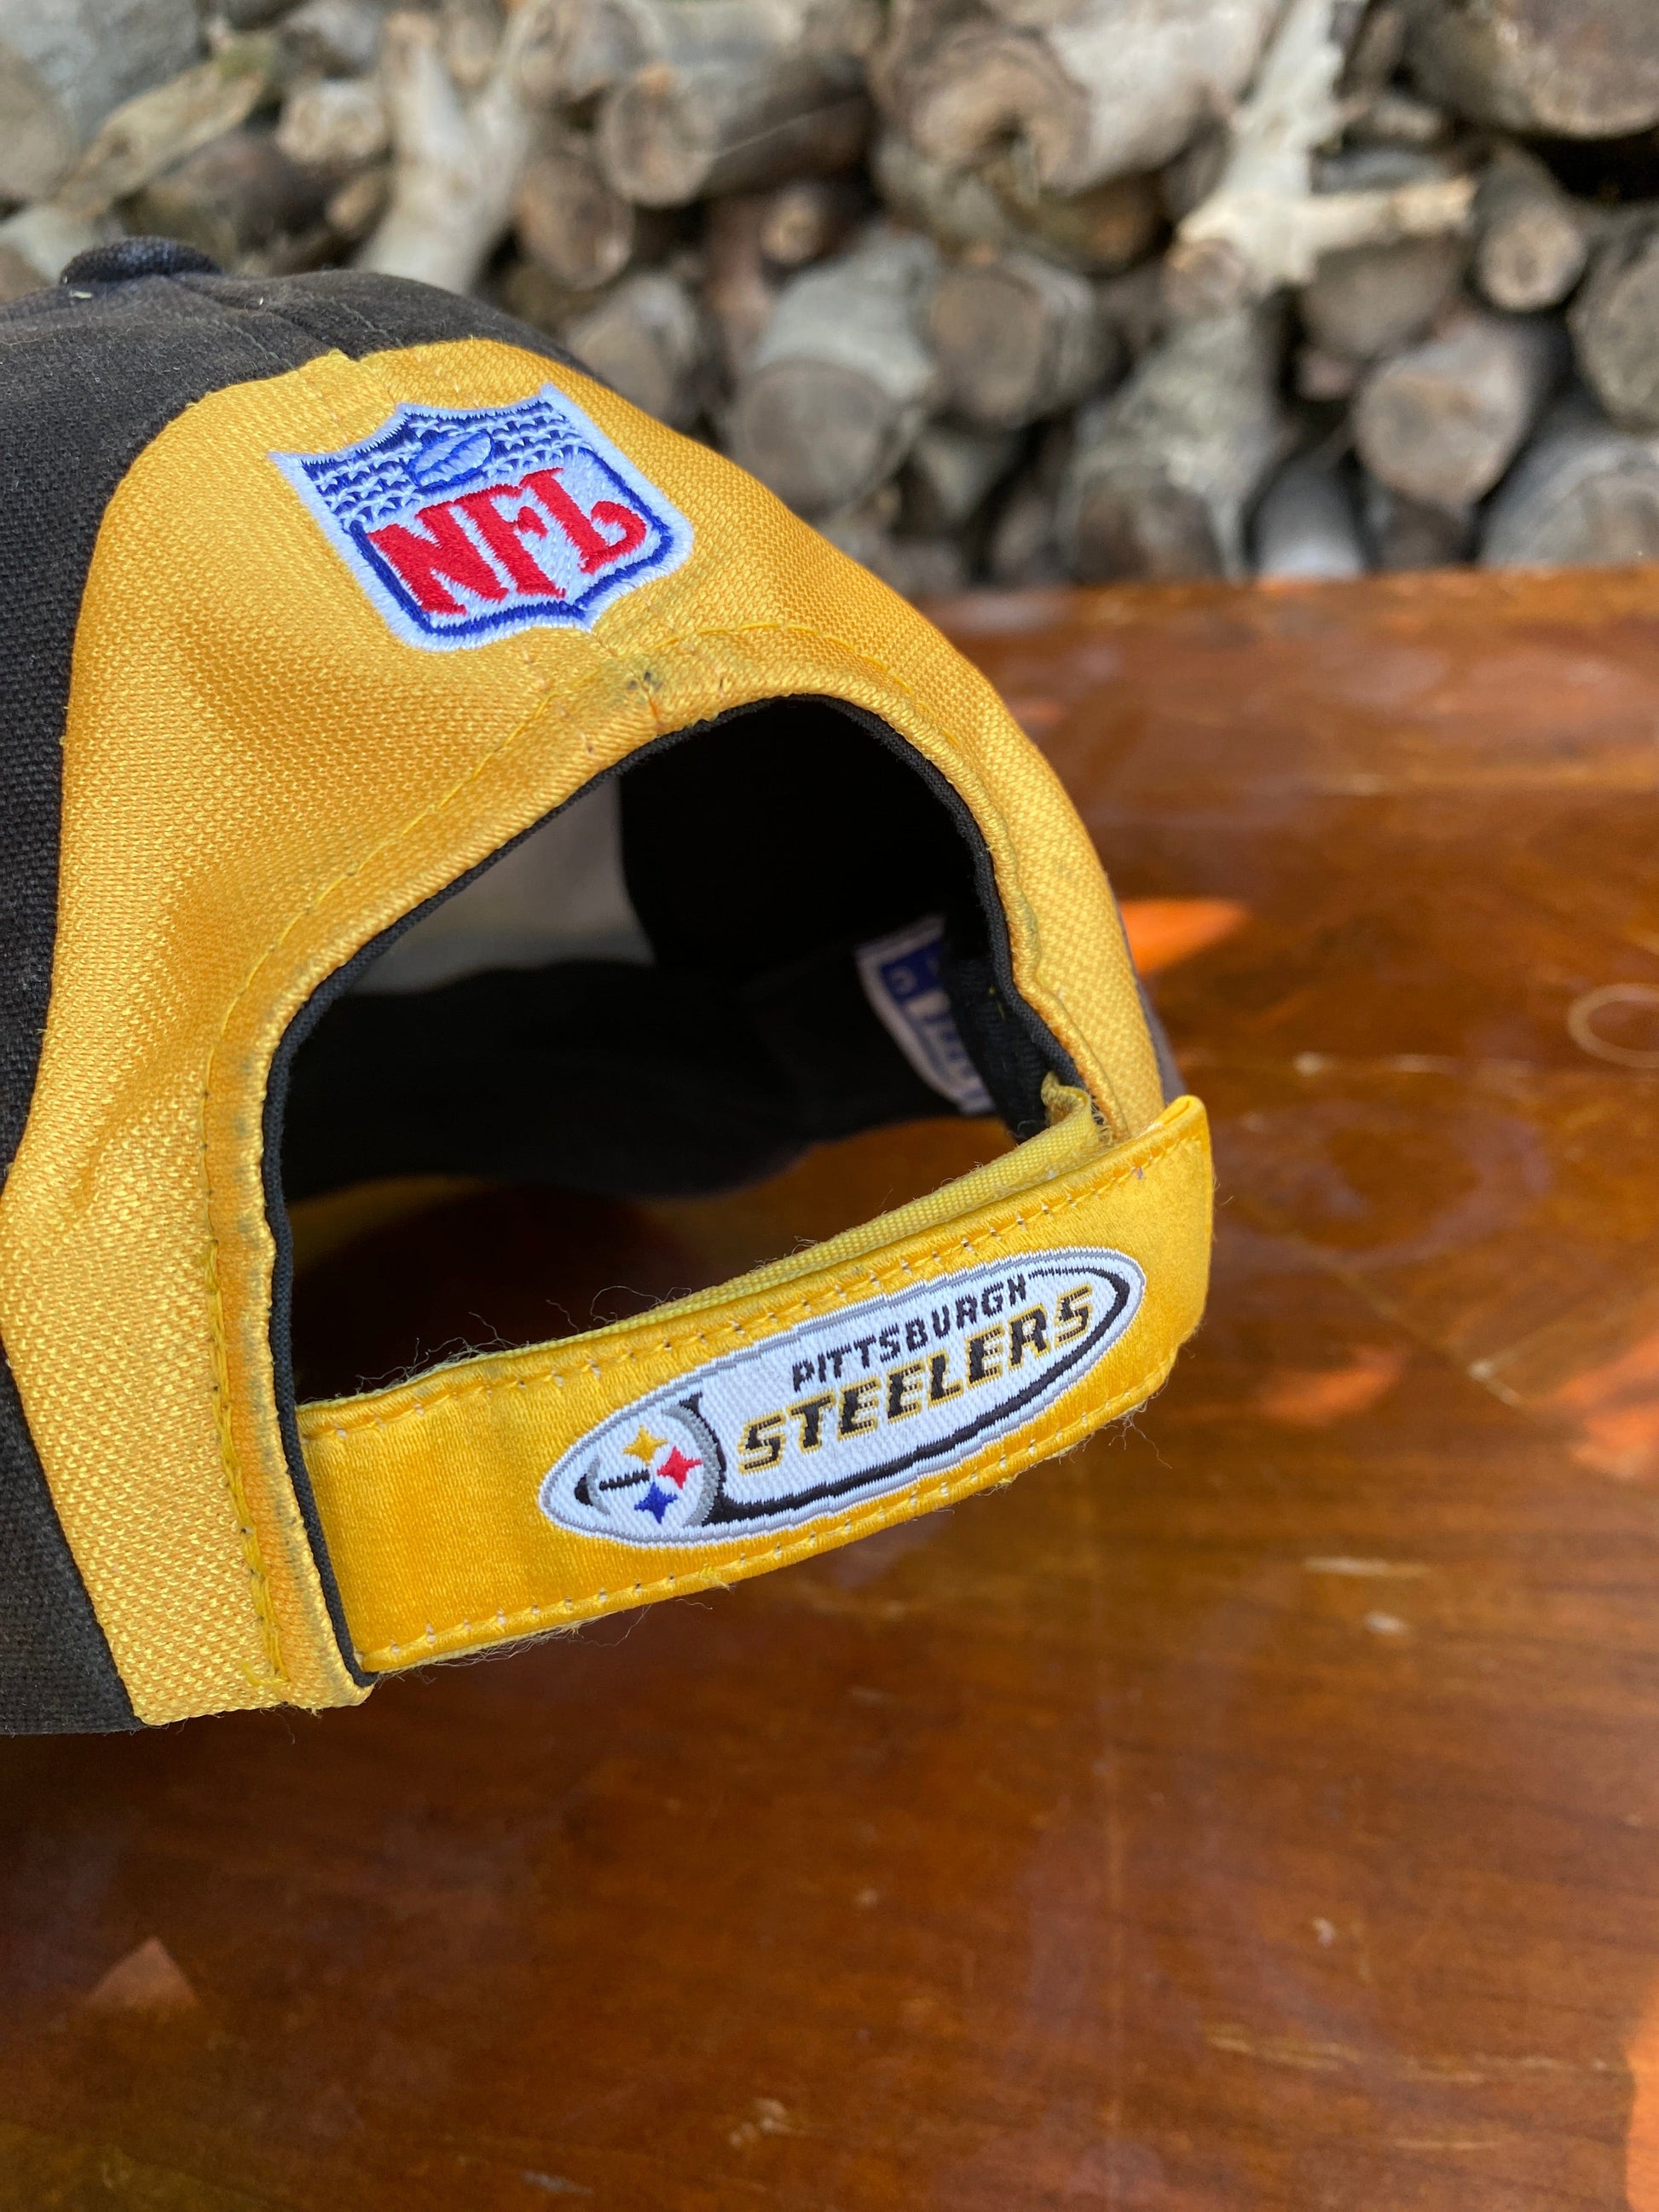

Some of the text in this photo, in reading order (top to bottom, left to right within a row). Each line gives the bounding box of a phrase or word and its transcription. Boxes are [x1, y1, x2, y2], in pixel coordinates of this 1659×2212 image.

[367, 468, 647, 615] NFL
[737, 1284, 1093, 1475] STEELERS
[792, 1274, 1028, 1391] PITTSBURGH
